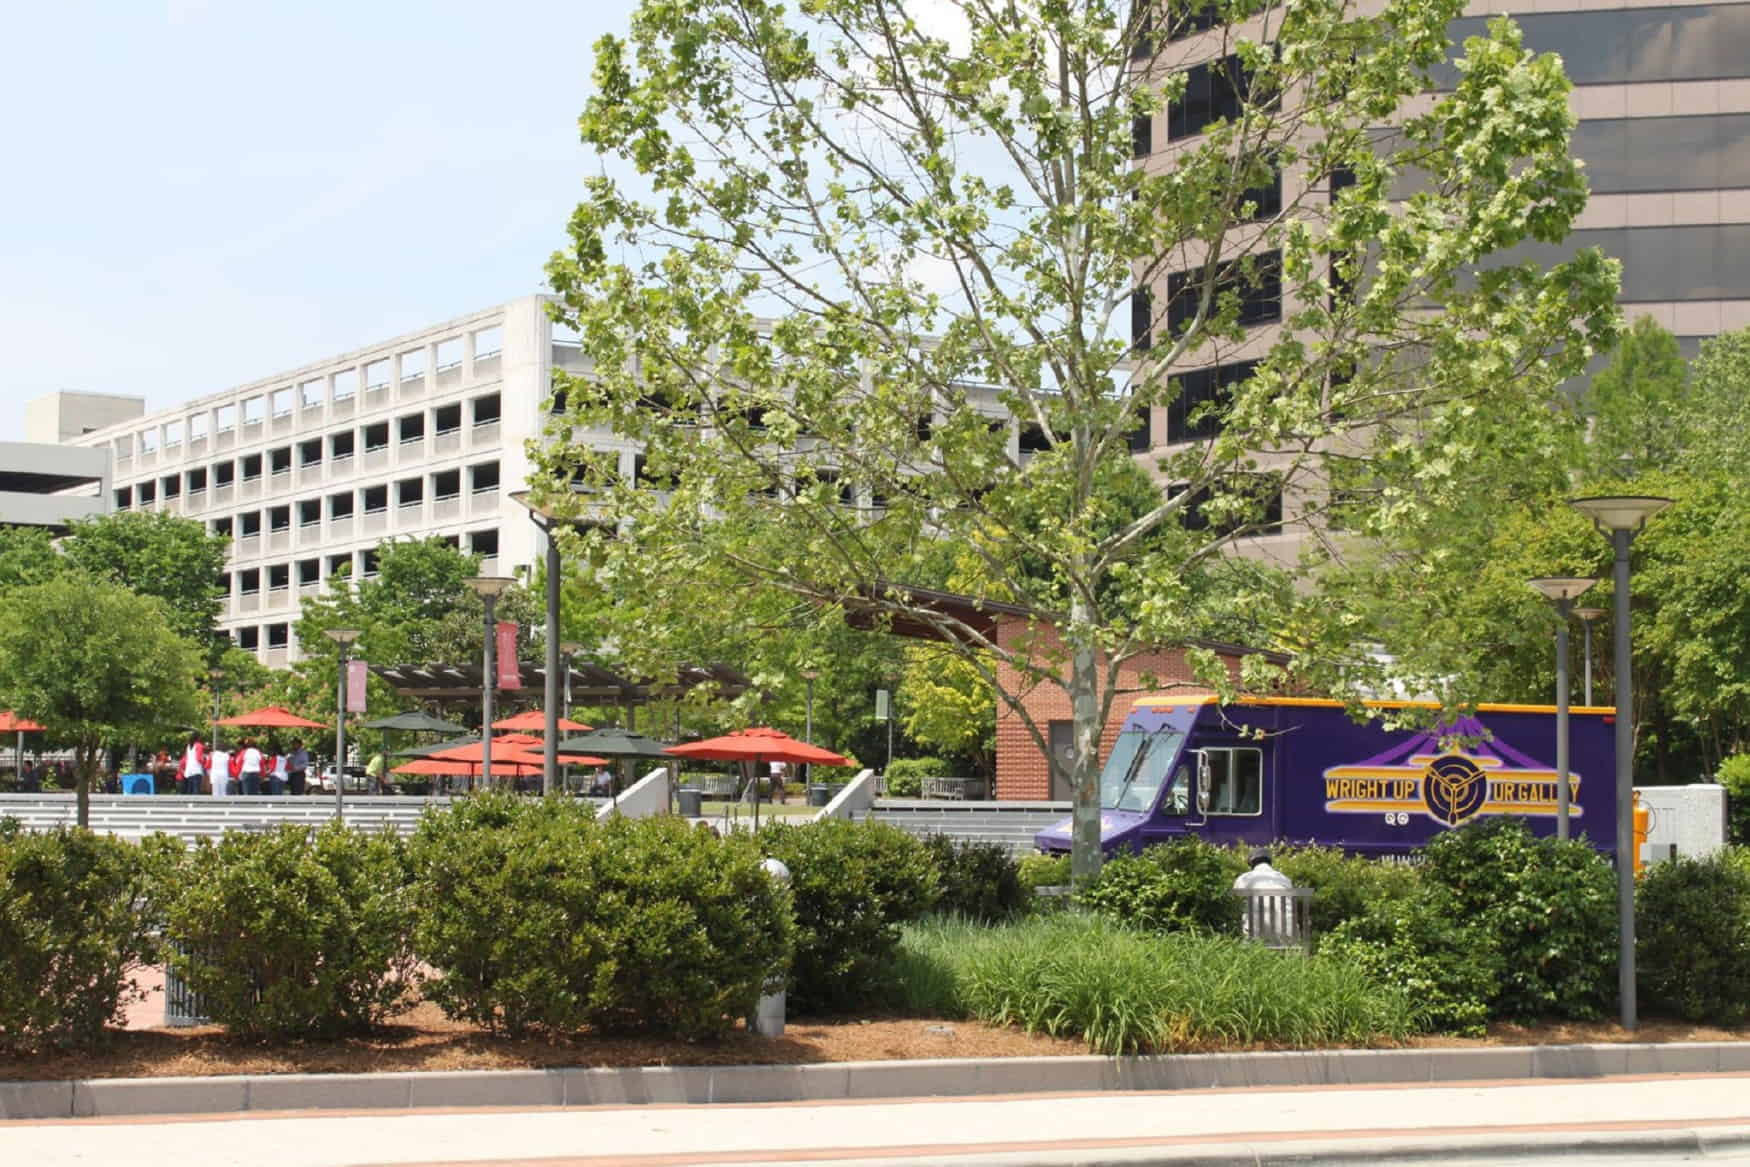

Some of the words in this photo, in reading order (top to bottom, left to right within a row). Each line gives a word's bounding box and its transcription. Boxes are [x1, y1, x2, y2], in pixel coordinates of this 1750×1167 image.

[1326, 779, 1387, 799] WRIGHT
[1393, 780, 1415, 800] UP
[1494, 783, 1514, 801] UR
[1519, 783, 1579, 803] GALLY
